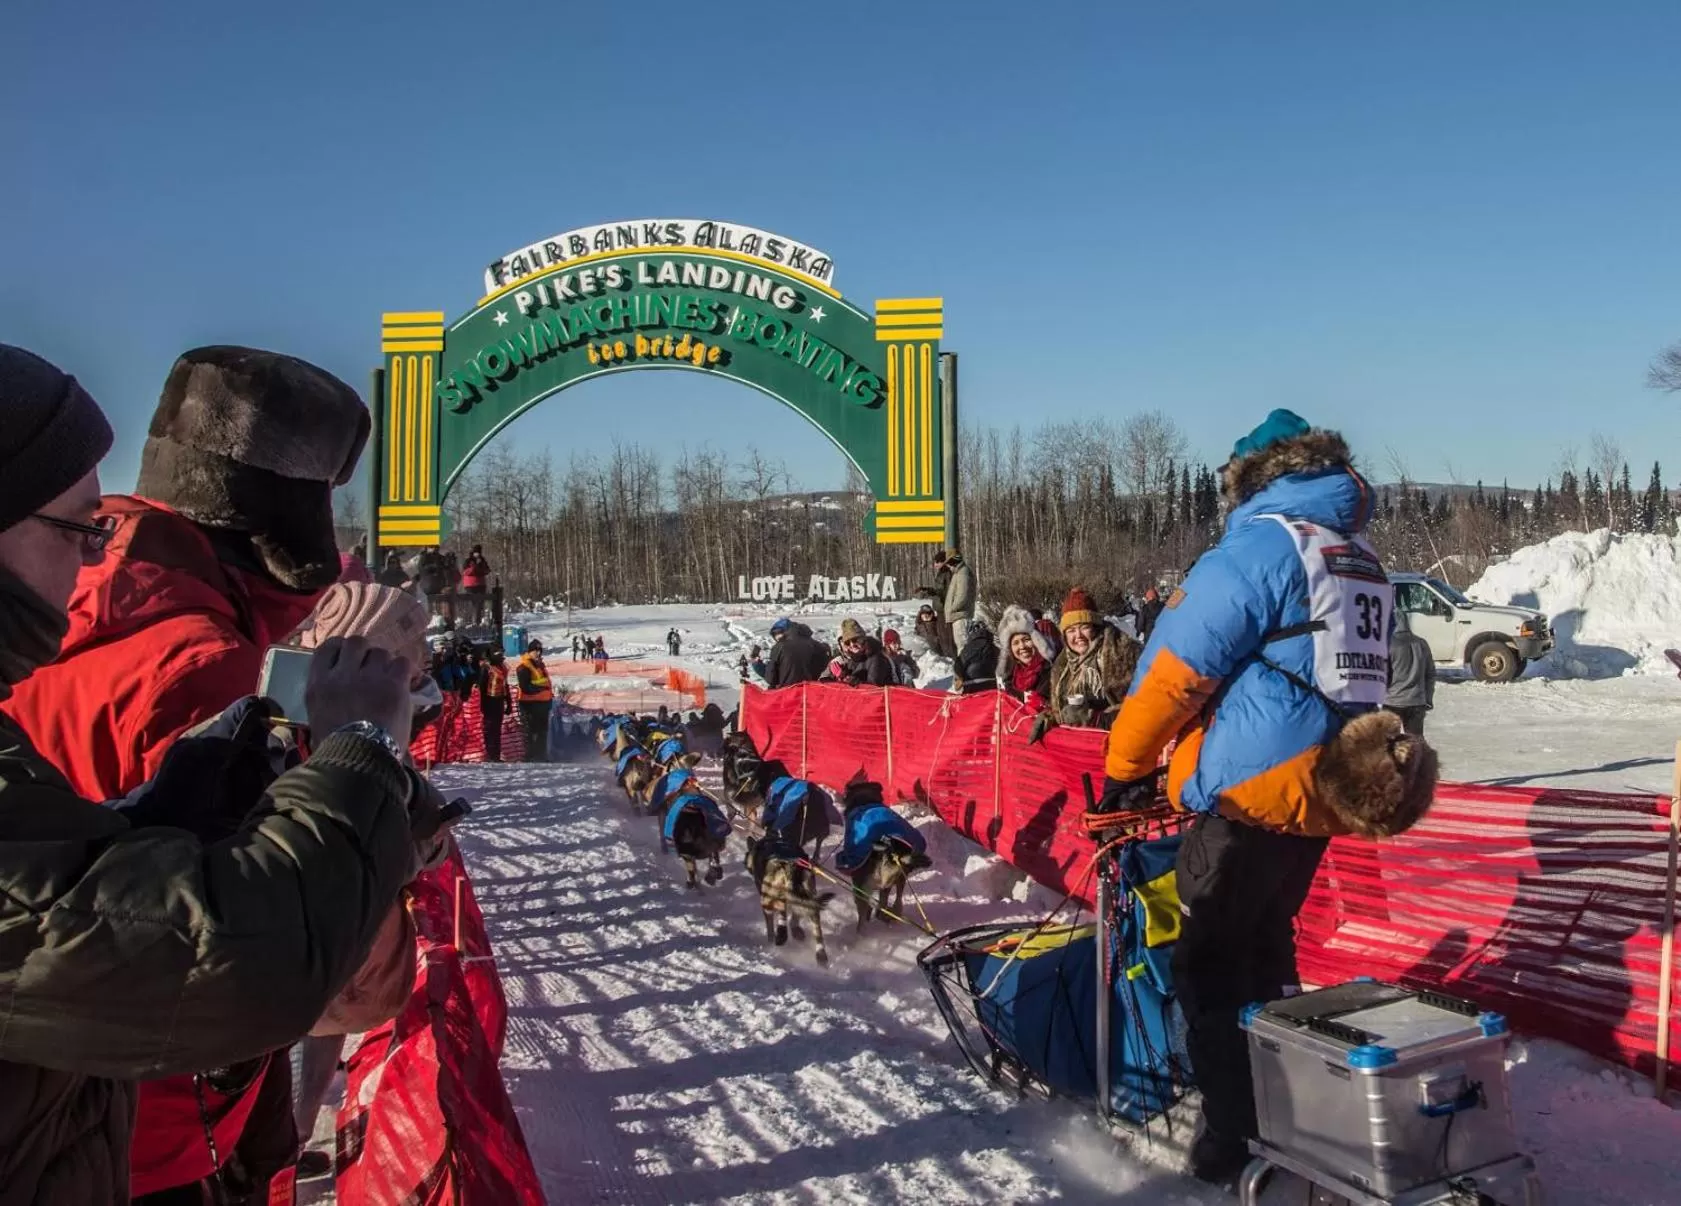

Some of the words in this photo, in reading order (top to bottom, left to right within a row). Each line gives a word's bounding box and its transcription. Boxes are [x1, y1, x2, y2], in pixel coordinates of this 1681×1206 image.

[490, 222, 684, 286] FAIRBANKS
[693, 221, 832, 280] ALASKA
[514, 264, 625, 315] PIKE'S
[638, 261, 798, 311] LANDING
[436, 294, 719, 410] SNOWMACHINES
[727, 305, 883, 406] BOATING
[634, 332, 722, 366] bridge
[738, 574, 795, 601] LOVE
[807, 573, 897, 601] ALASKA
[1355, 593, 1383, 641] 33
[1335, 652, 1387, 672] IDITARO
